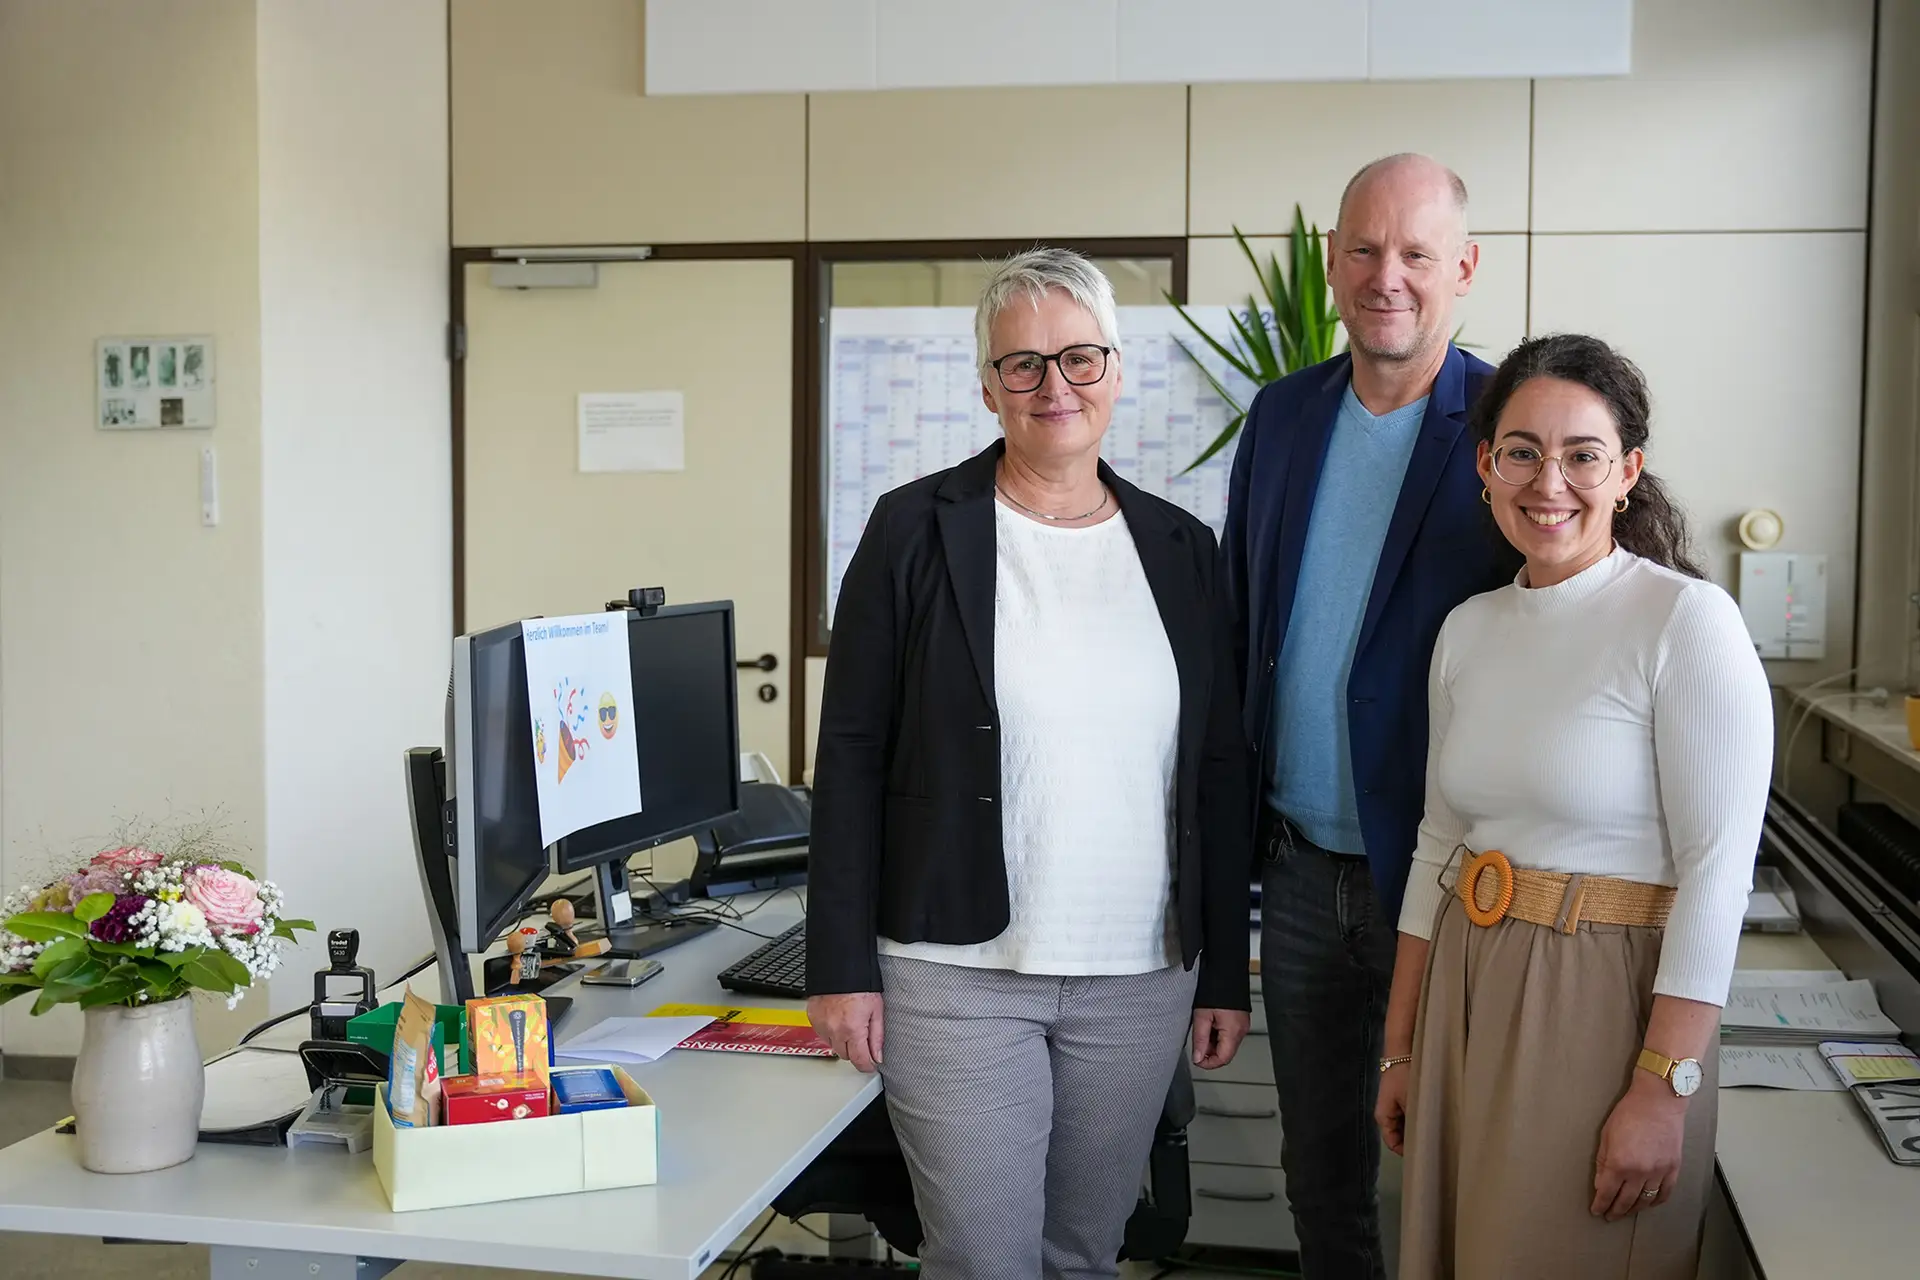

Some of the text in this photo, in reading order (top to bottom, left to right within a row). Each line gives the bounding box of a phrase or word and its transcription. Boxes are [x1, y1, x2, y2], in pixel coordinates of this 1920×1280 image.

[548, 624, 583, 639] Willkommen
[584, 622, 591, 634] im
[592, 619, 608, 634] Team!
[682, 1040, 834, 1057] VERKEHRSDIENS
